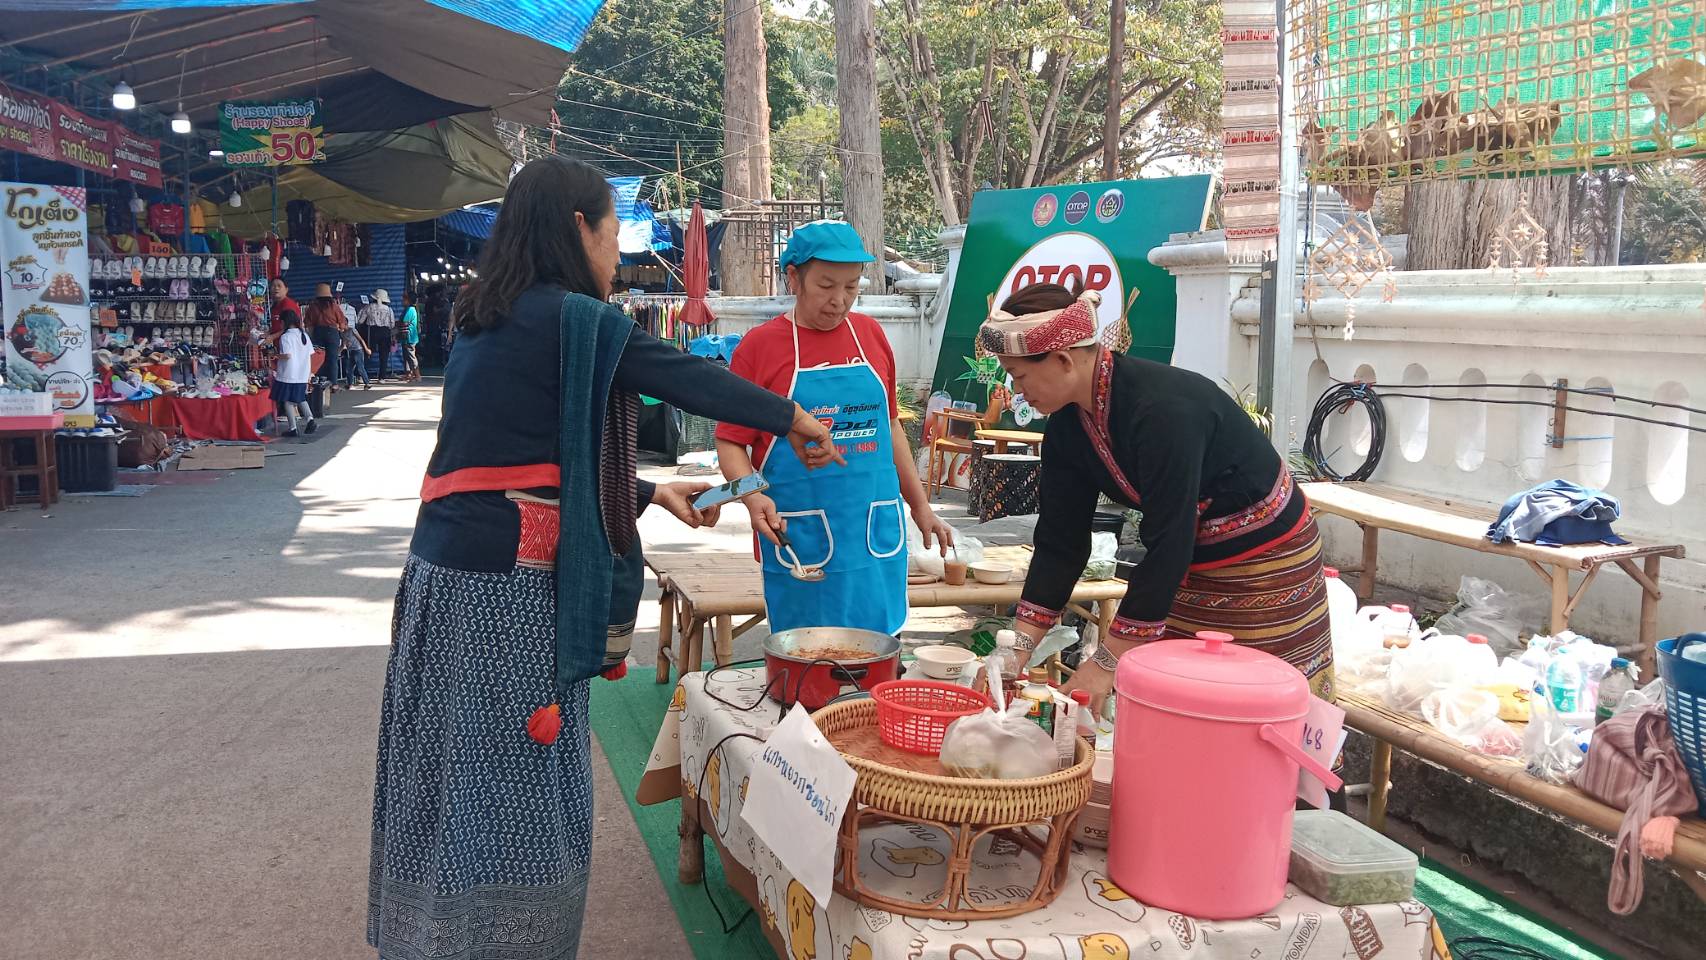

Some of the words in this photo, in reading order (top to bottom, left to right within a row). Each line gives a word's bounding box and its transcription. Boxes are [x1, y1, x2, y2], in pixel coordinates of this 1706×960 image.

[232, 116, 270, 130] (Happy
[272, 116, 310, 128] Shoes)
[227, 150, 272, 164] รองเท้า
[1067, 202, 1088, 211] OTOP
[836, 429, 875, 438] POWER
